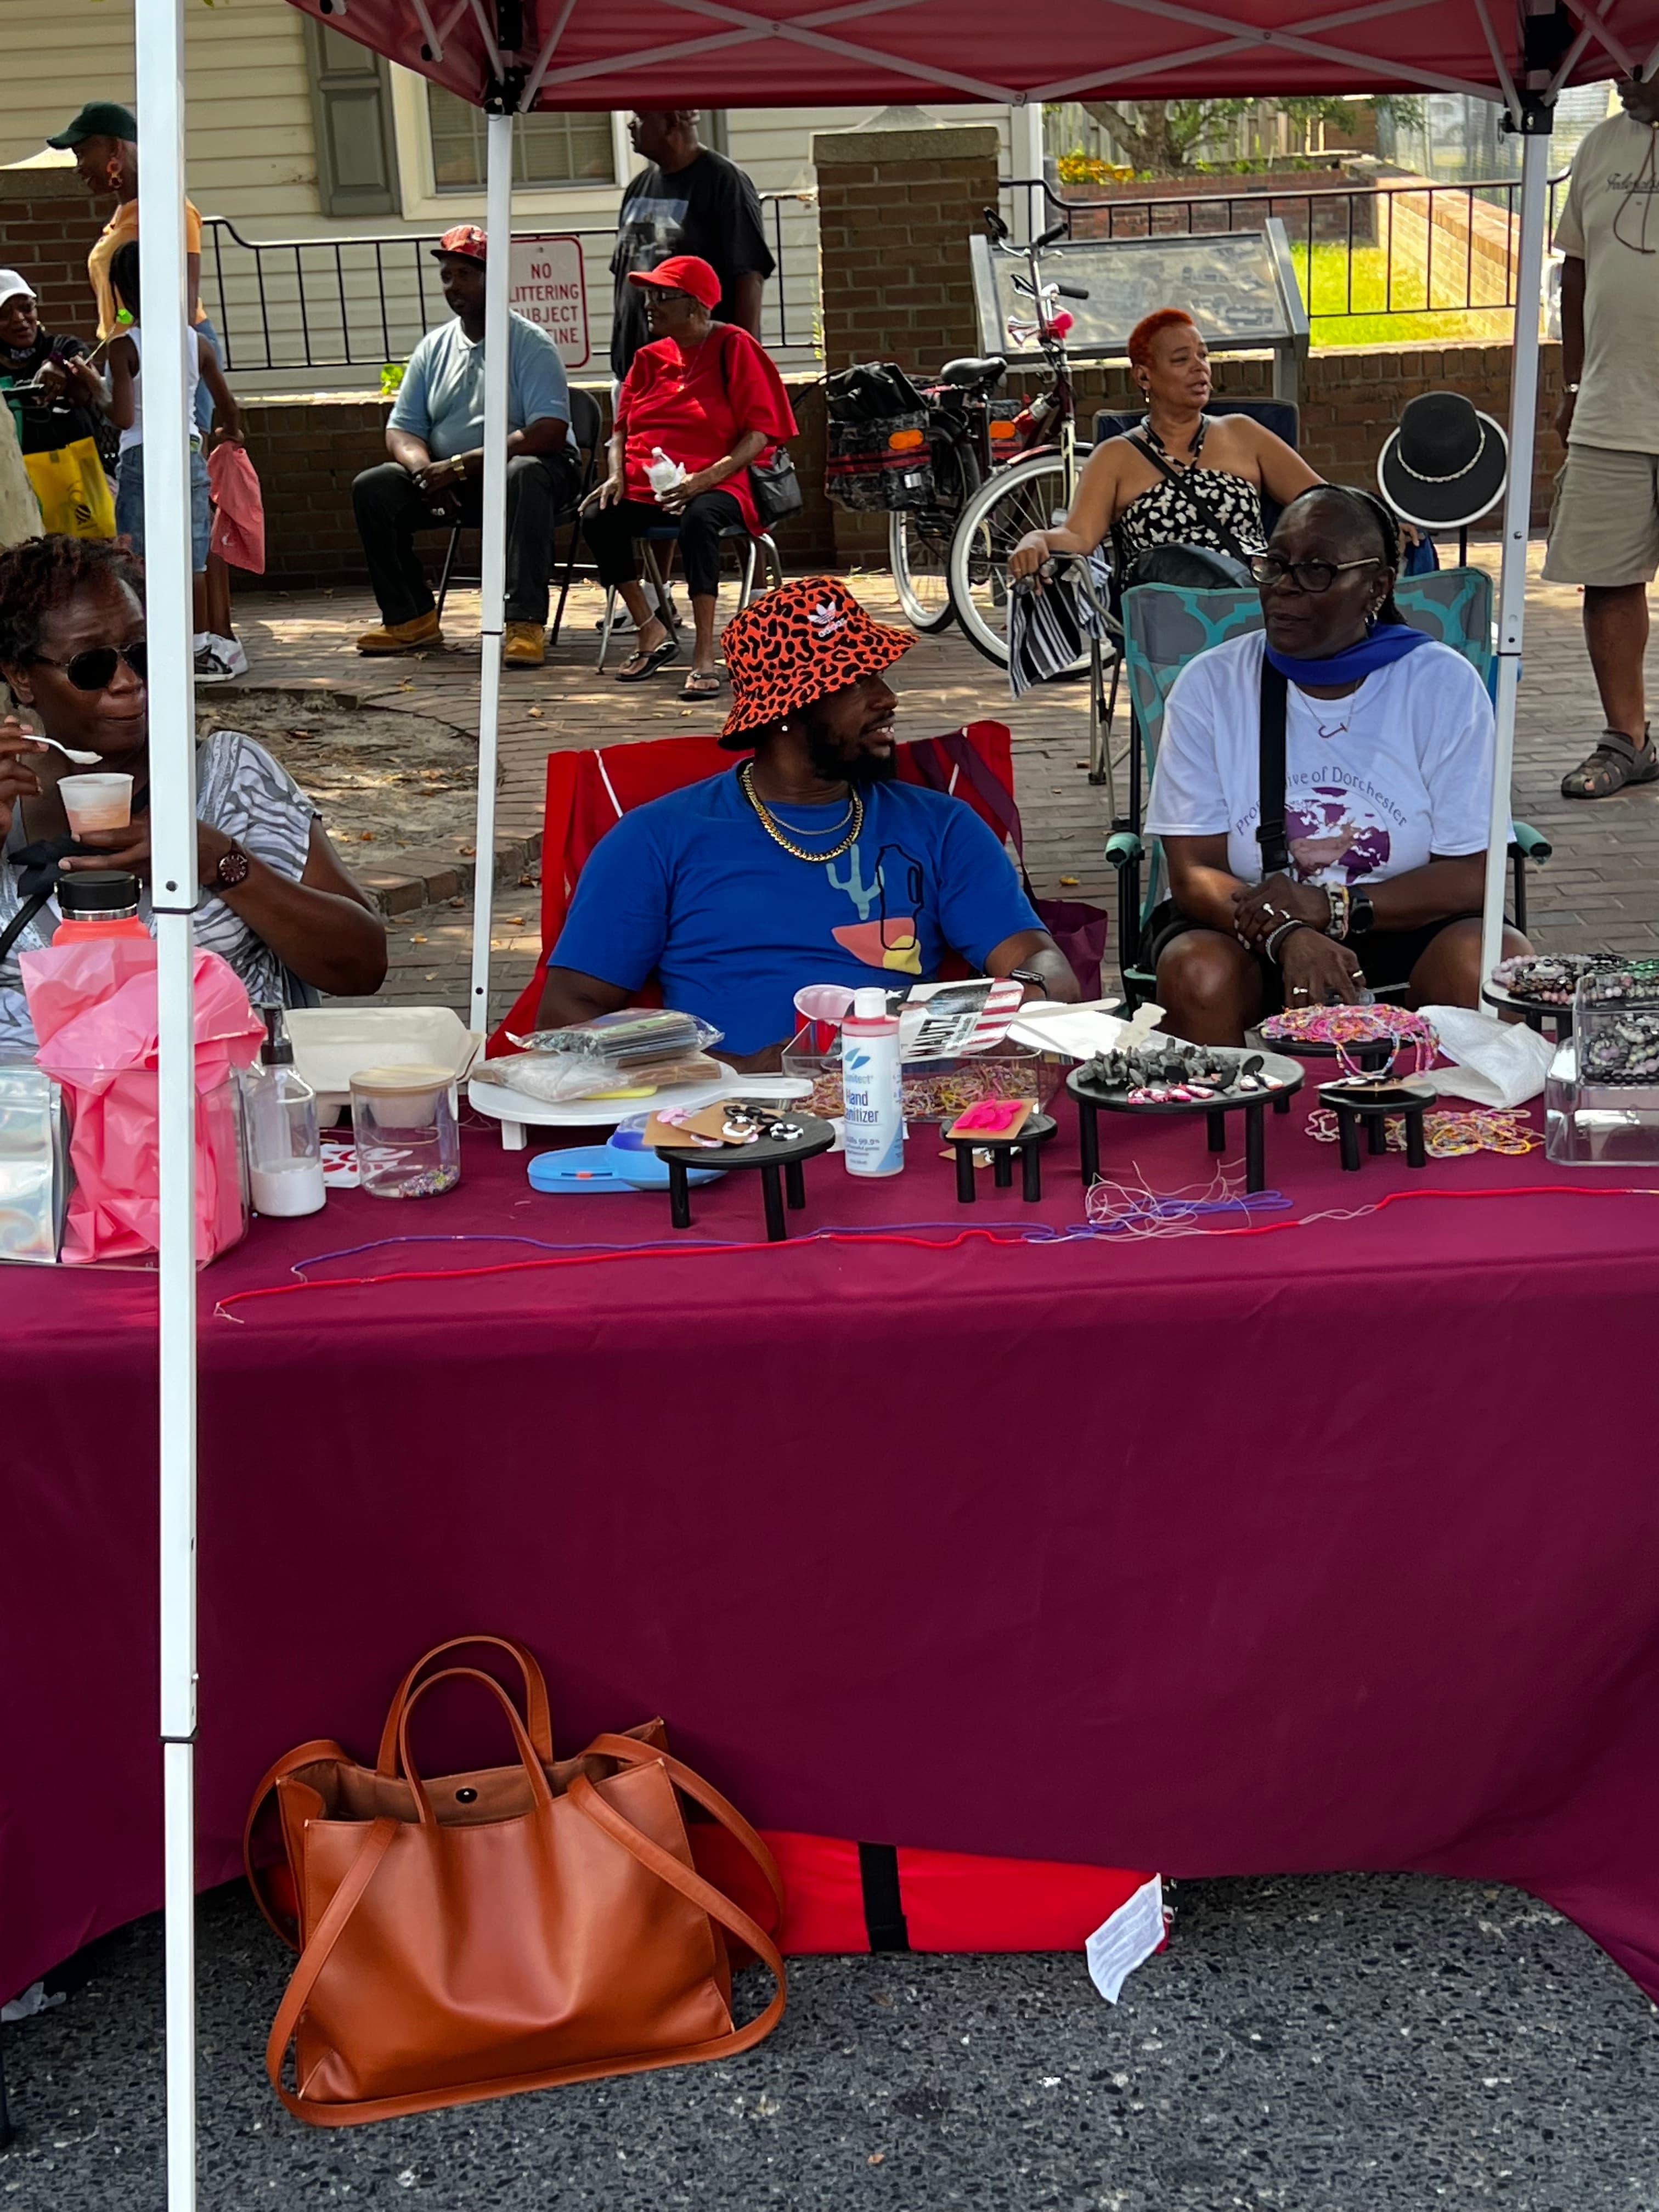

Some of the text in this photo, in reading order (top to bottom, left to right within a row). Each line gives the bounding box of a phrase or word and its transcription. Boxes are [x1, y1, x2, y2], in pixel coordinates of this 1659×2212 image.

[531, 263, 552, 279] NO
[512, 306, 578, 323] UBJECT
[1312, 765, 1328, 782] of
[1332, 766, 1407, 826] Dorchester
[846, 1089, 868, 1106] Hand
[845, 1108, 879, 1122] anitizer
